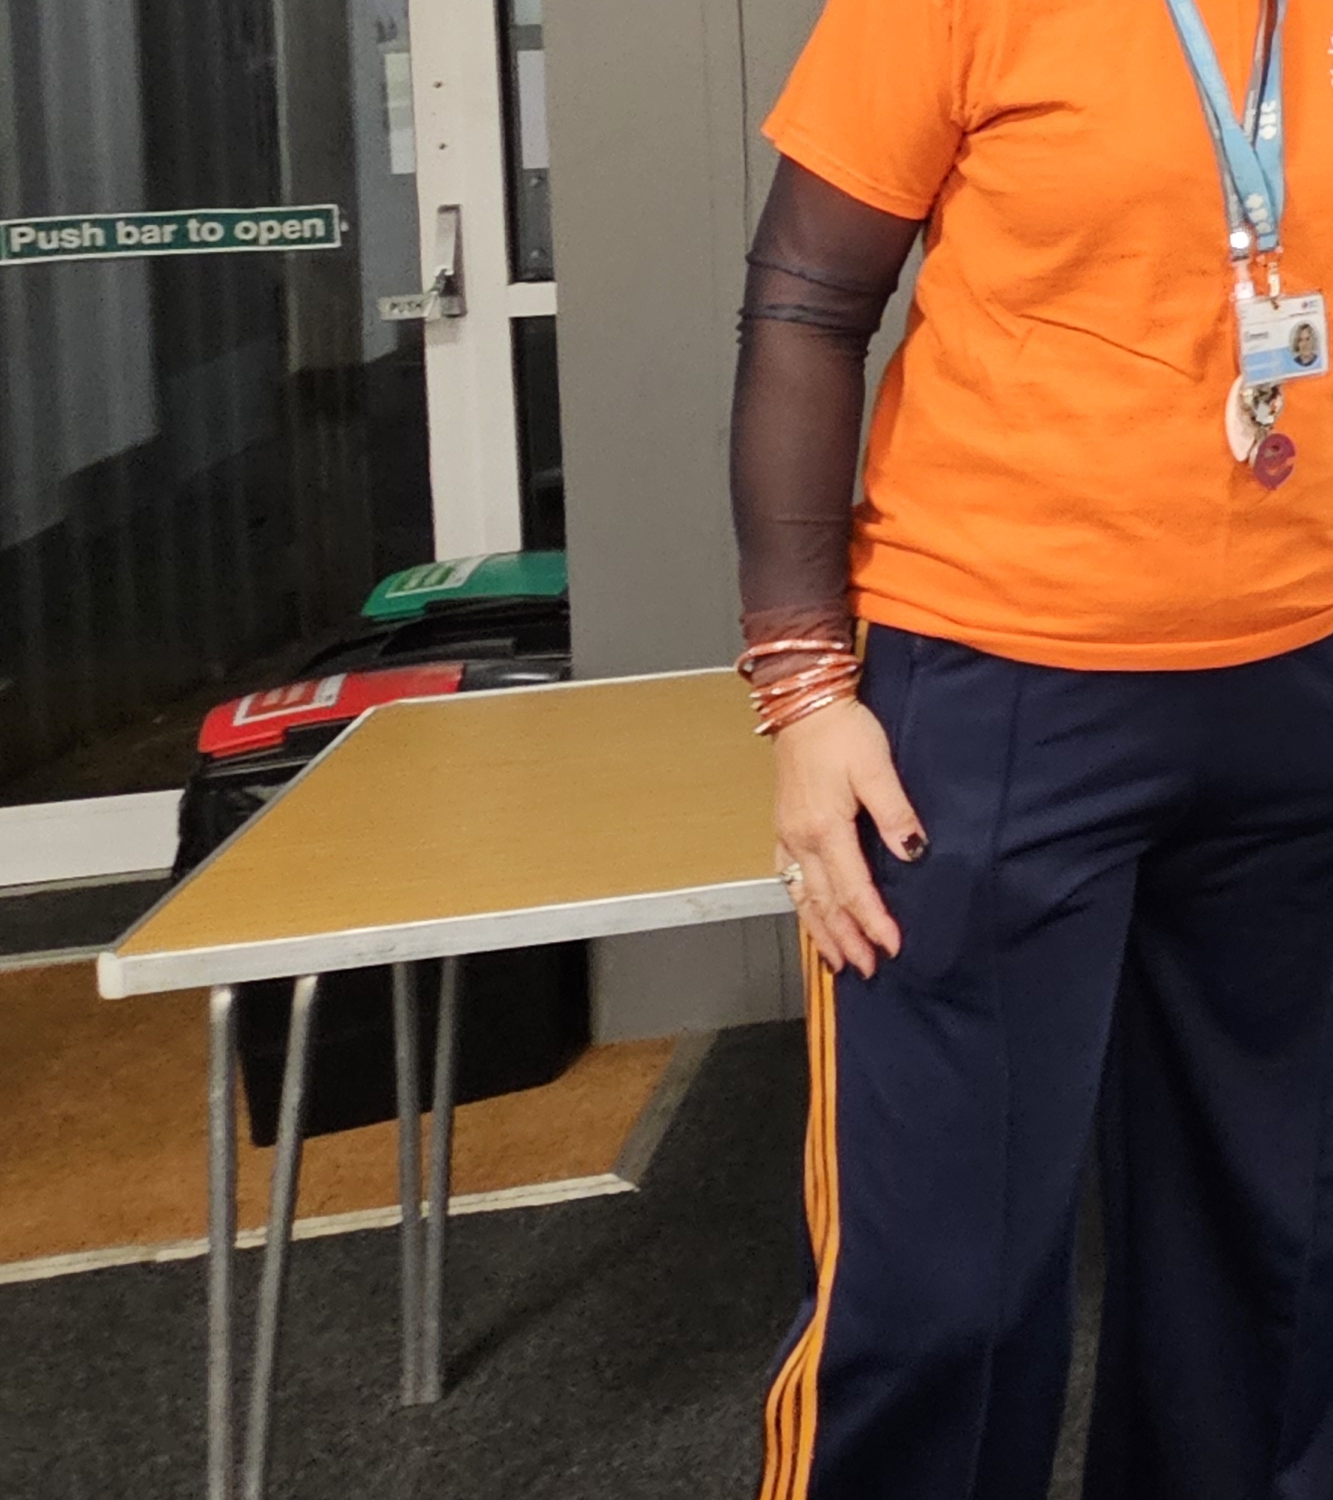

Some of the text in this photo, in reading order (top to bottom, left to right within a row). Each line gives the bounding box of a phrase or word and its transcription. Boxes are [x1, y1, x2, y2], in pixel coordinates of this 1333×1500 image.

[10, 217, 326, 251] Push bar to open
